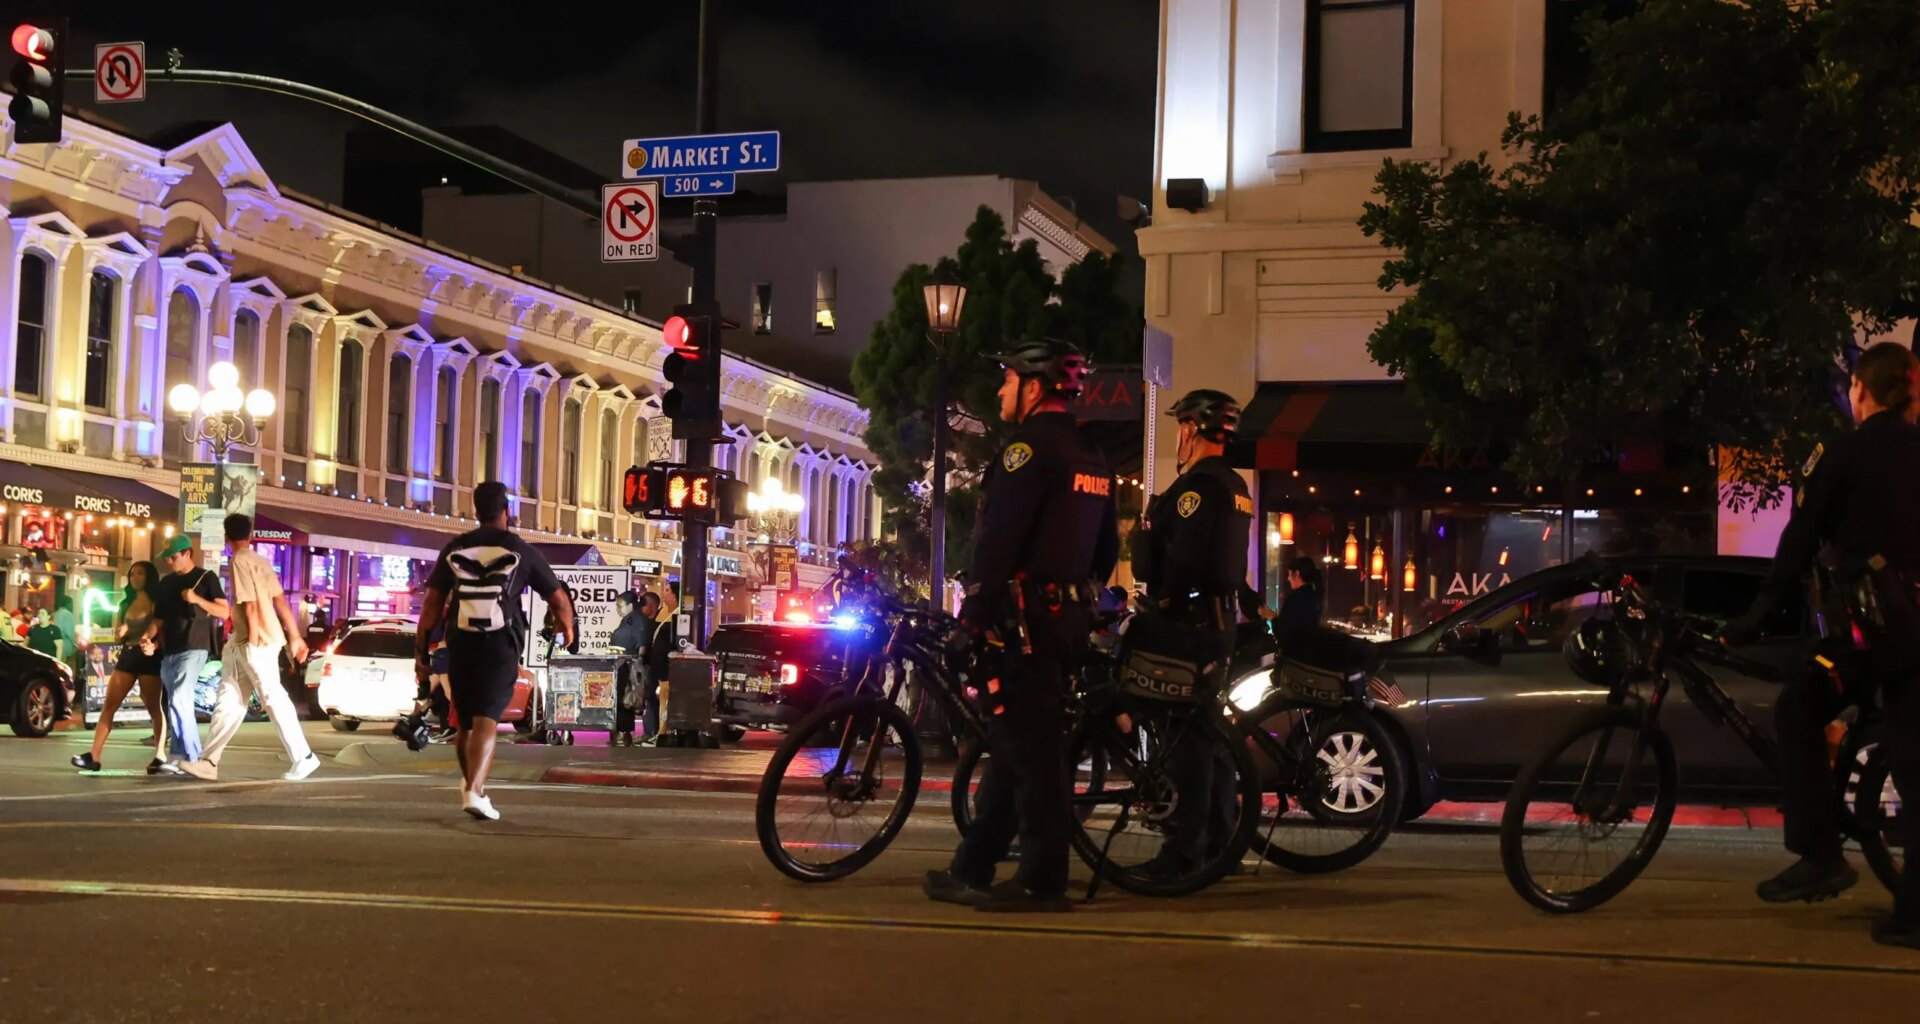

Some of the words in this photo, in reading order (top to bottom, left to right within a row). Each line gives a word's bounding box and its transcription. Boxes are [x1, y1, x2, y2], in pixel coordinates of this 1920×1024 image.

[674, 177, 700, 193] 500
[607, 245, 623, 257] ON
[630, 243, 653, 256] RED
[649, 435, 661, 453] OK
[193, 475, 204, 483] THE
[1073, 473, 1110, 496] POLICE
[4, 485, 43, 504] CORKS
[181, 482, 214, 493] POPULAR
[75, 495, 111, 513] FORKS
[187, 492, 208, 503] ARTS
[125, 502, 151, 518] TAPS
[253, 530, 293, 539] TUESDAY
[566, 574, 614, 585] AVENUE
[569, 587, 619, 603] OSED
[577, 605, 611, 614] DWAY-
[591, 616, 605, 625] ST
[584, 631, 592, 639] 3,
[1126, 668, 1194, 697] POLICE
